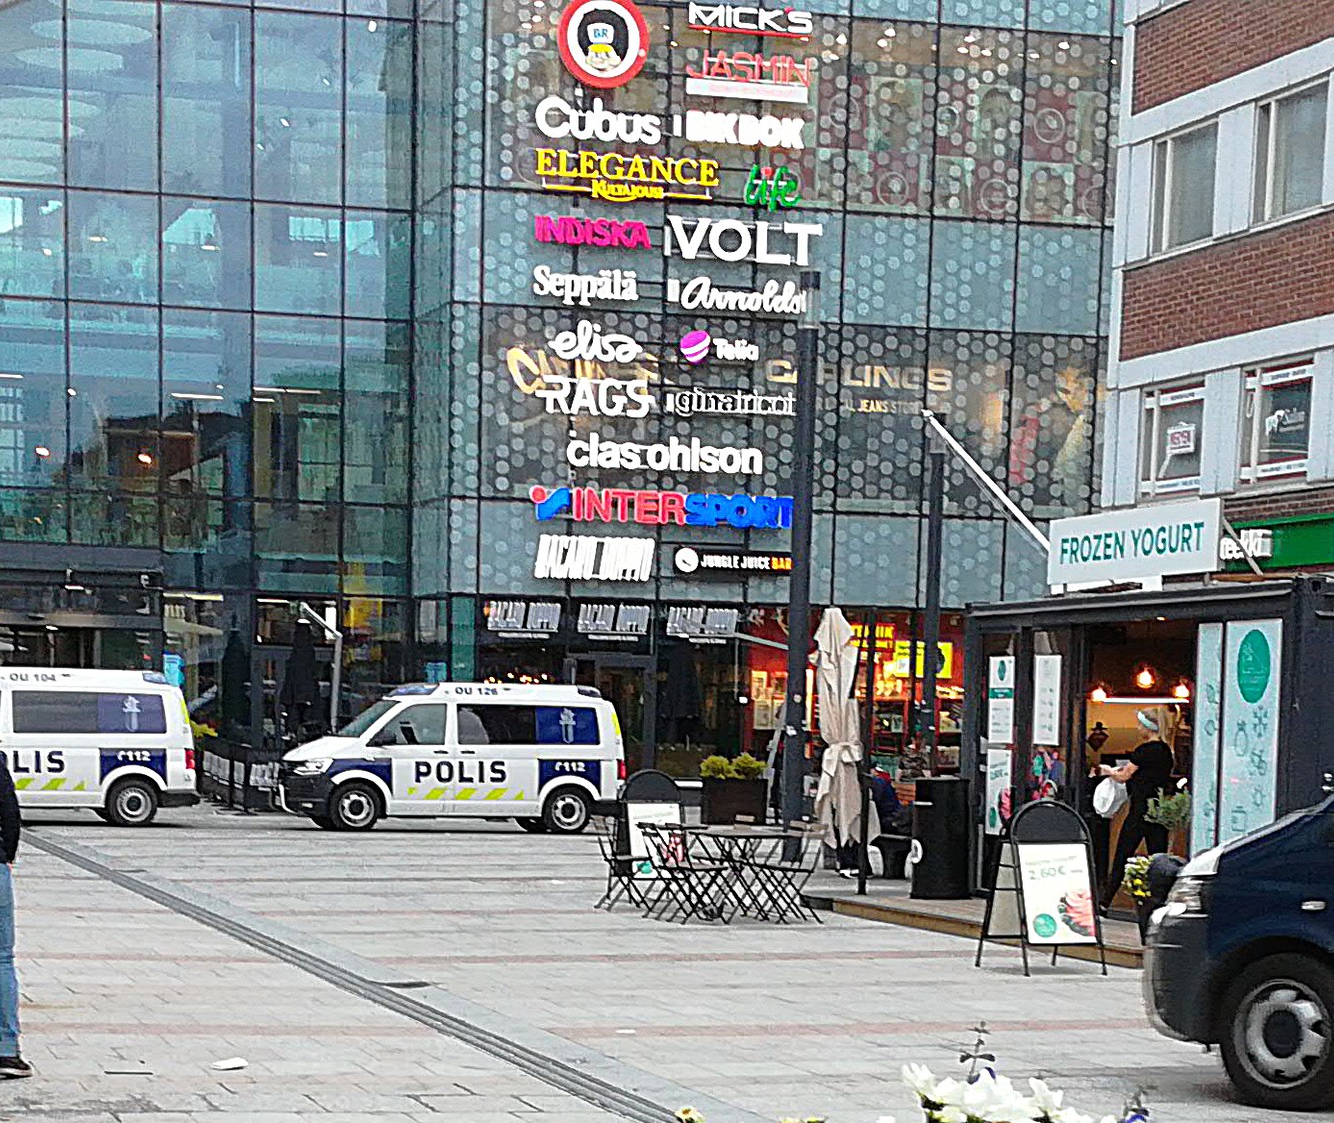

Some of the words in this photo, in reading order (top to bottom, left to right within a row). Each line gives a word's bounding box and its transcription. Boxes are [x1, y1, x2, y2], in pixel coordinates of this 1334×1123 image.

[686, 49, 811, 87] JASMIN
[535, 95, 661, 145] Cubus
[535, 147, 720, 187] ELEGANCE
[667, 215, 824, 267] VOLT
[533, 265, 639, 306] Seppälä
[548, 320, 643, 363] elisa
[713, 338, 759, 361] Telia
[767, 359, 953, 391] CRLINGS
[535, 375, 656, 417] RAGS
[571, 486, 794, 529] INTERSPORT
[1059, 531, 1125, 564] FROZEN
[1131, 521, 1205, 557] YOGURT
[740, 556, 770, 570] JUICE
[771, 556, 793, 570] BAR
[455, 686, 473, 695] OU
[12, 750, 66, 774] LIS
[414, 760, 507, 784] POLIS
